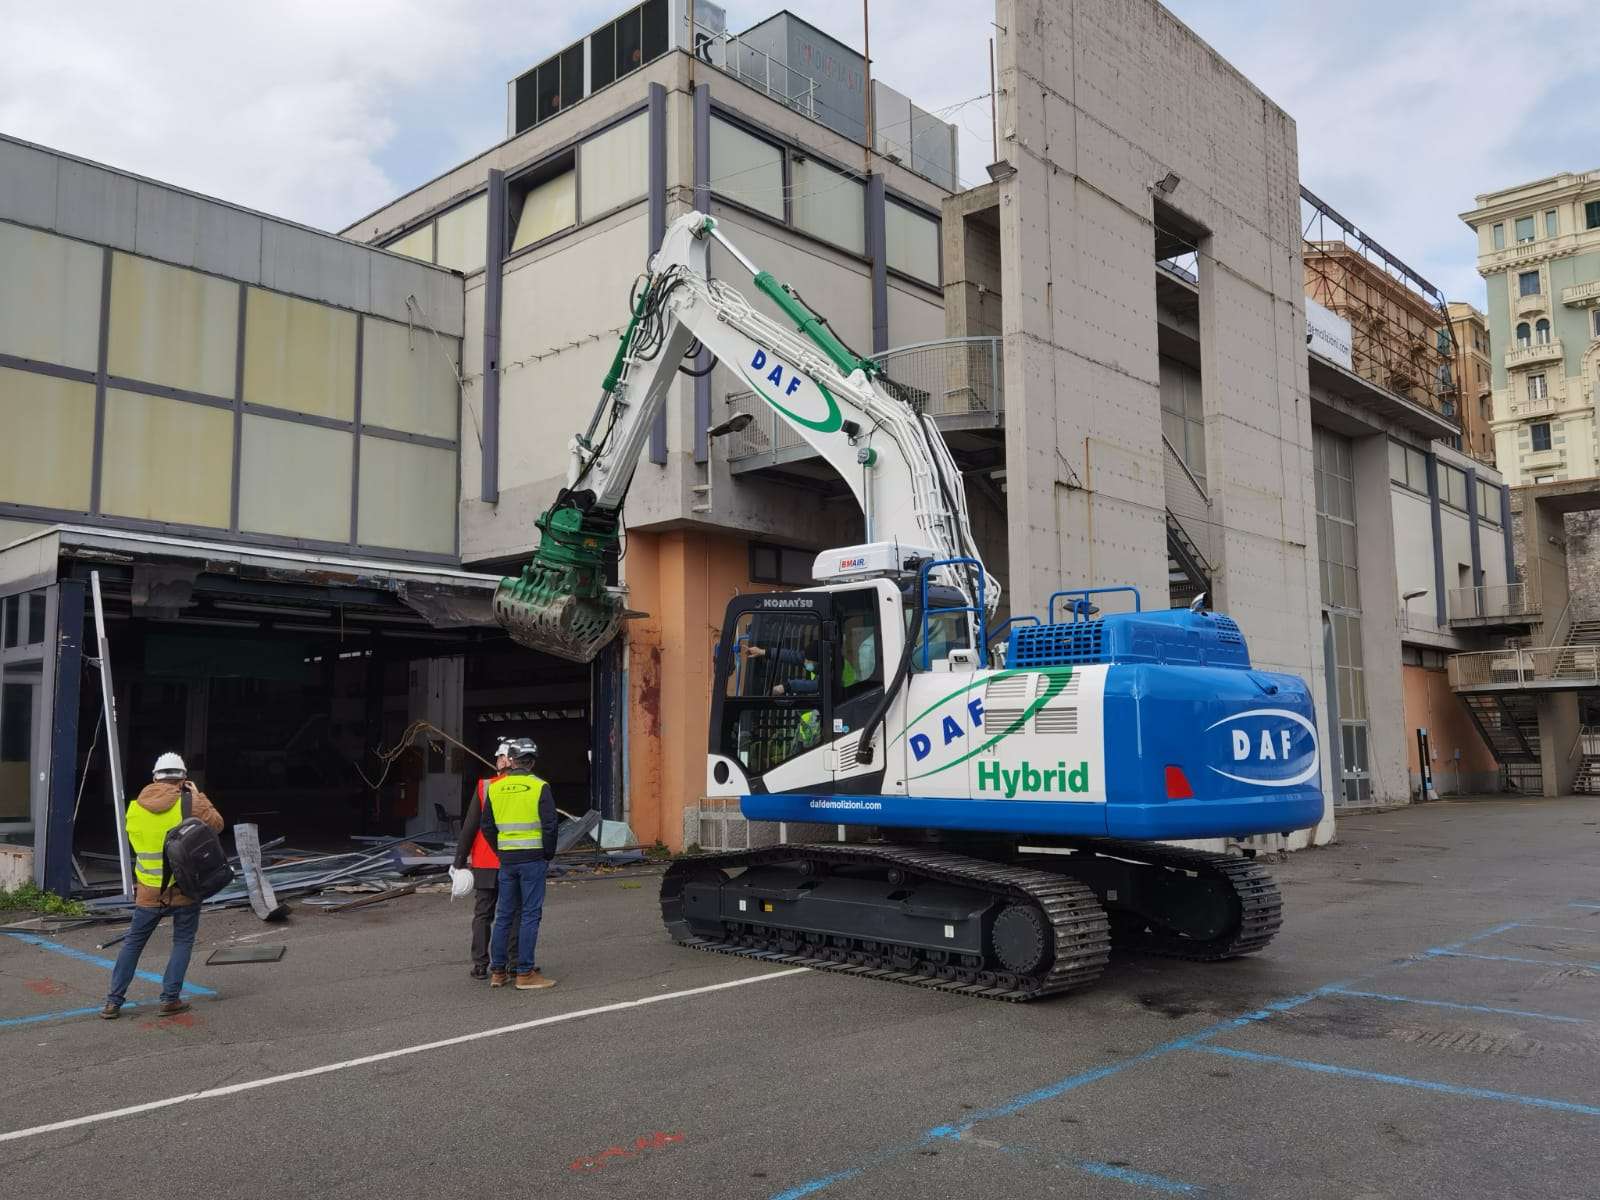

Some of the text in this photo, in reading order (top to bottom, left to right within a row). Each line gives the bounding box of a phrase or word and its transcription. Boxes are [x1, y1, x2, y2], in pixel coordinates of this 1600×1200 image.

[751, 348, 801, 396] DAF
[841, 558, 865, 568] BMAIR
[763, 598, 814, 607] KOMATSU
[909, 697, 985, 762] DAF
[1232, 729, 1291, 760] DAF
[978, 761, 1089, 799] Hybrid
[809, 799, 882, 810] dafdemolizioni.com
